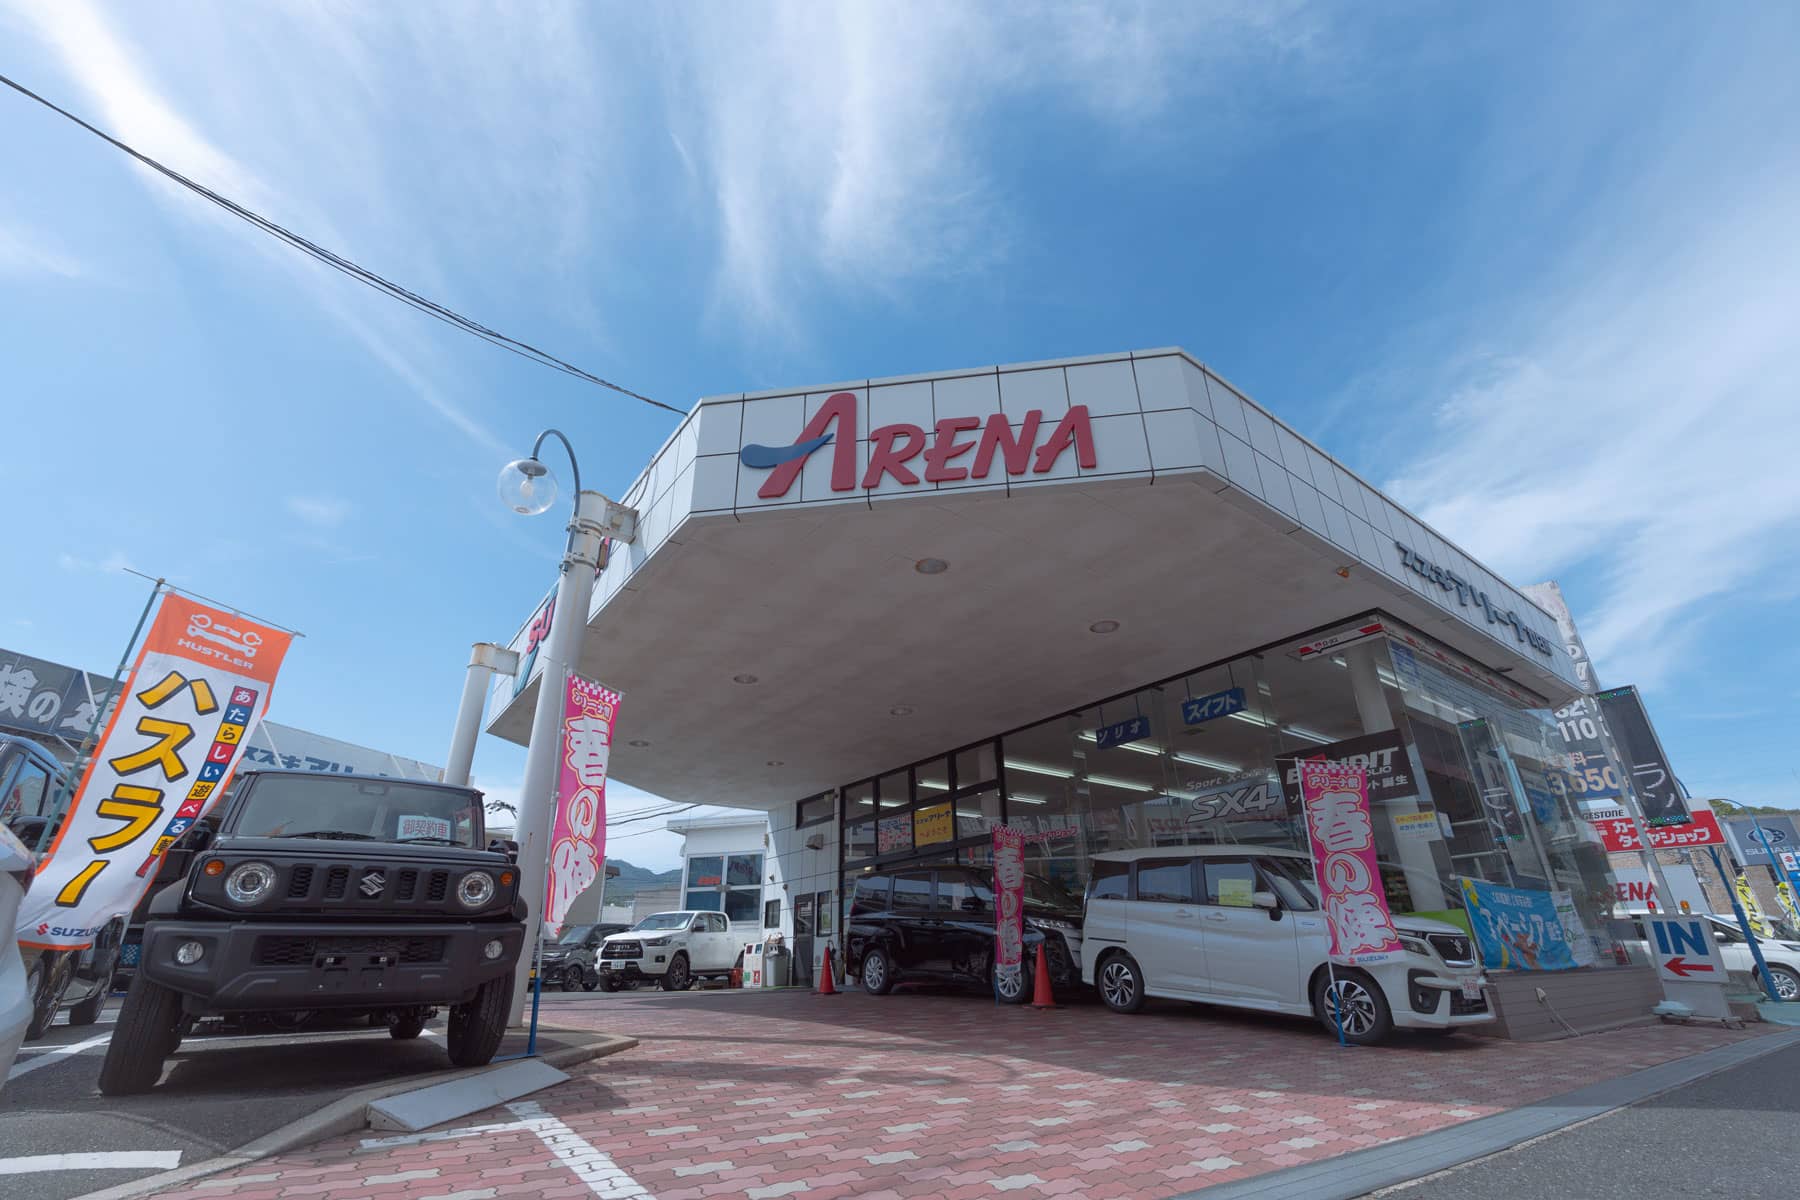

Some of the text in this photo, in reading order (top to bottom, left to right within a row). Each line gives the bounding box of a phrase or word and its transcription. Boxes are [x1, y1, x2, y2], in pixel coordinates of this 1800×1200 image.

[741, 392, 1097, 498] ARENA
[177, 637, 254, 670] HUSTLER
[1188, 693, 1237, 721] スイフト
[55, 670, 219, 908] ハスラー
[1184, 783, 1280, 824] SX4
[50, 924, 101, 938] SUZUK
[1652, 921, 1709, 956] IN
